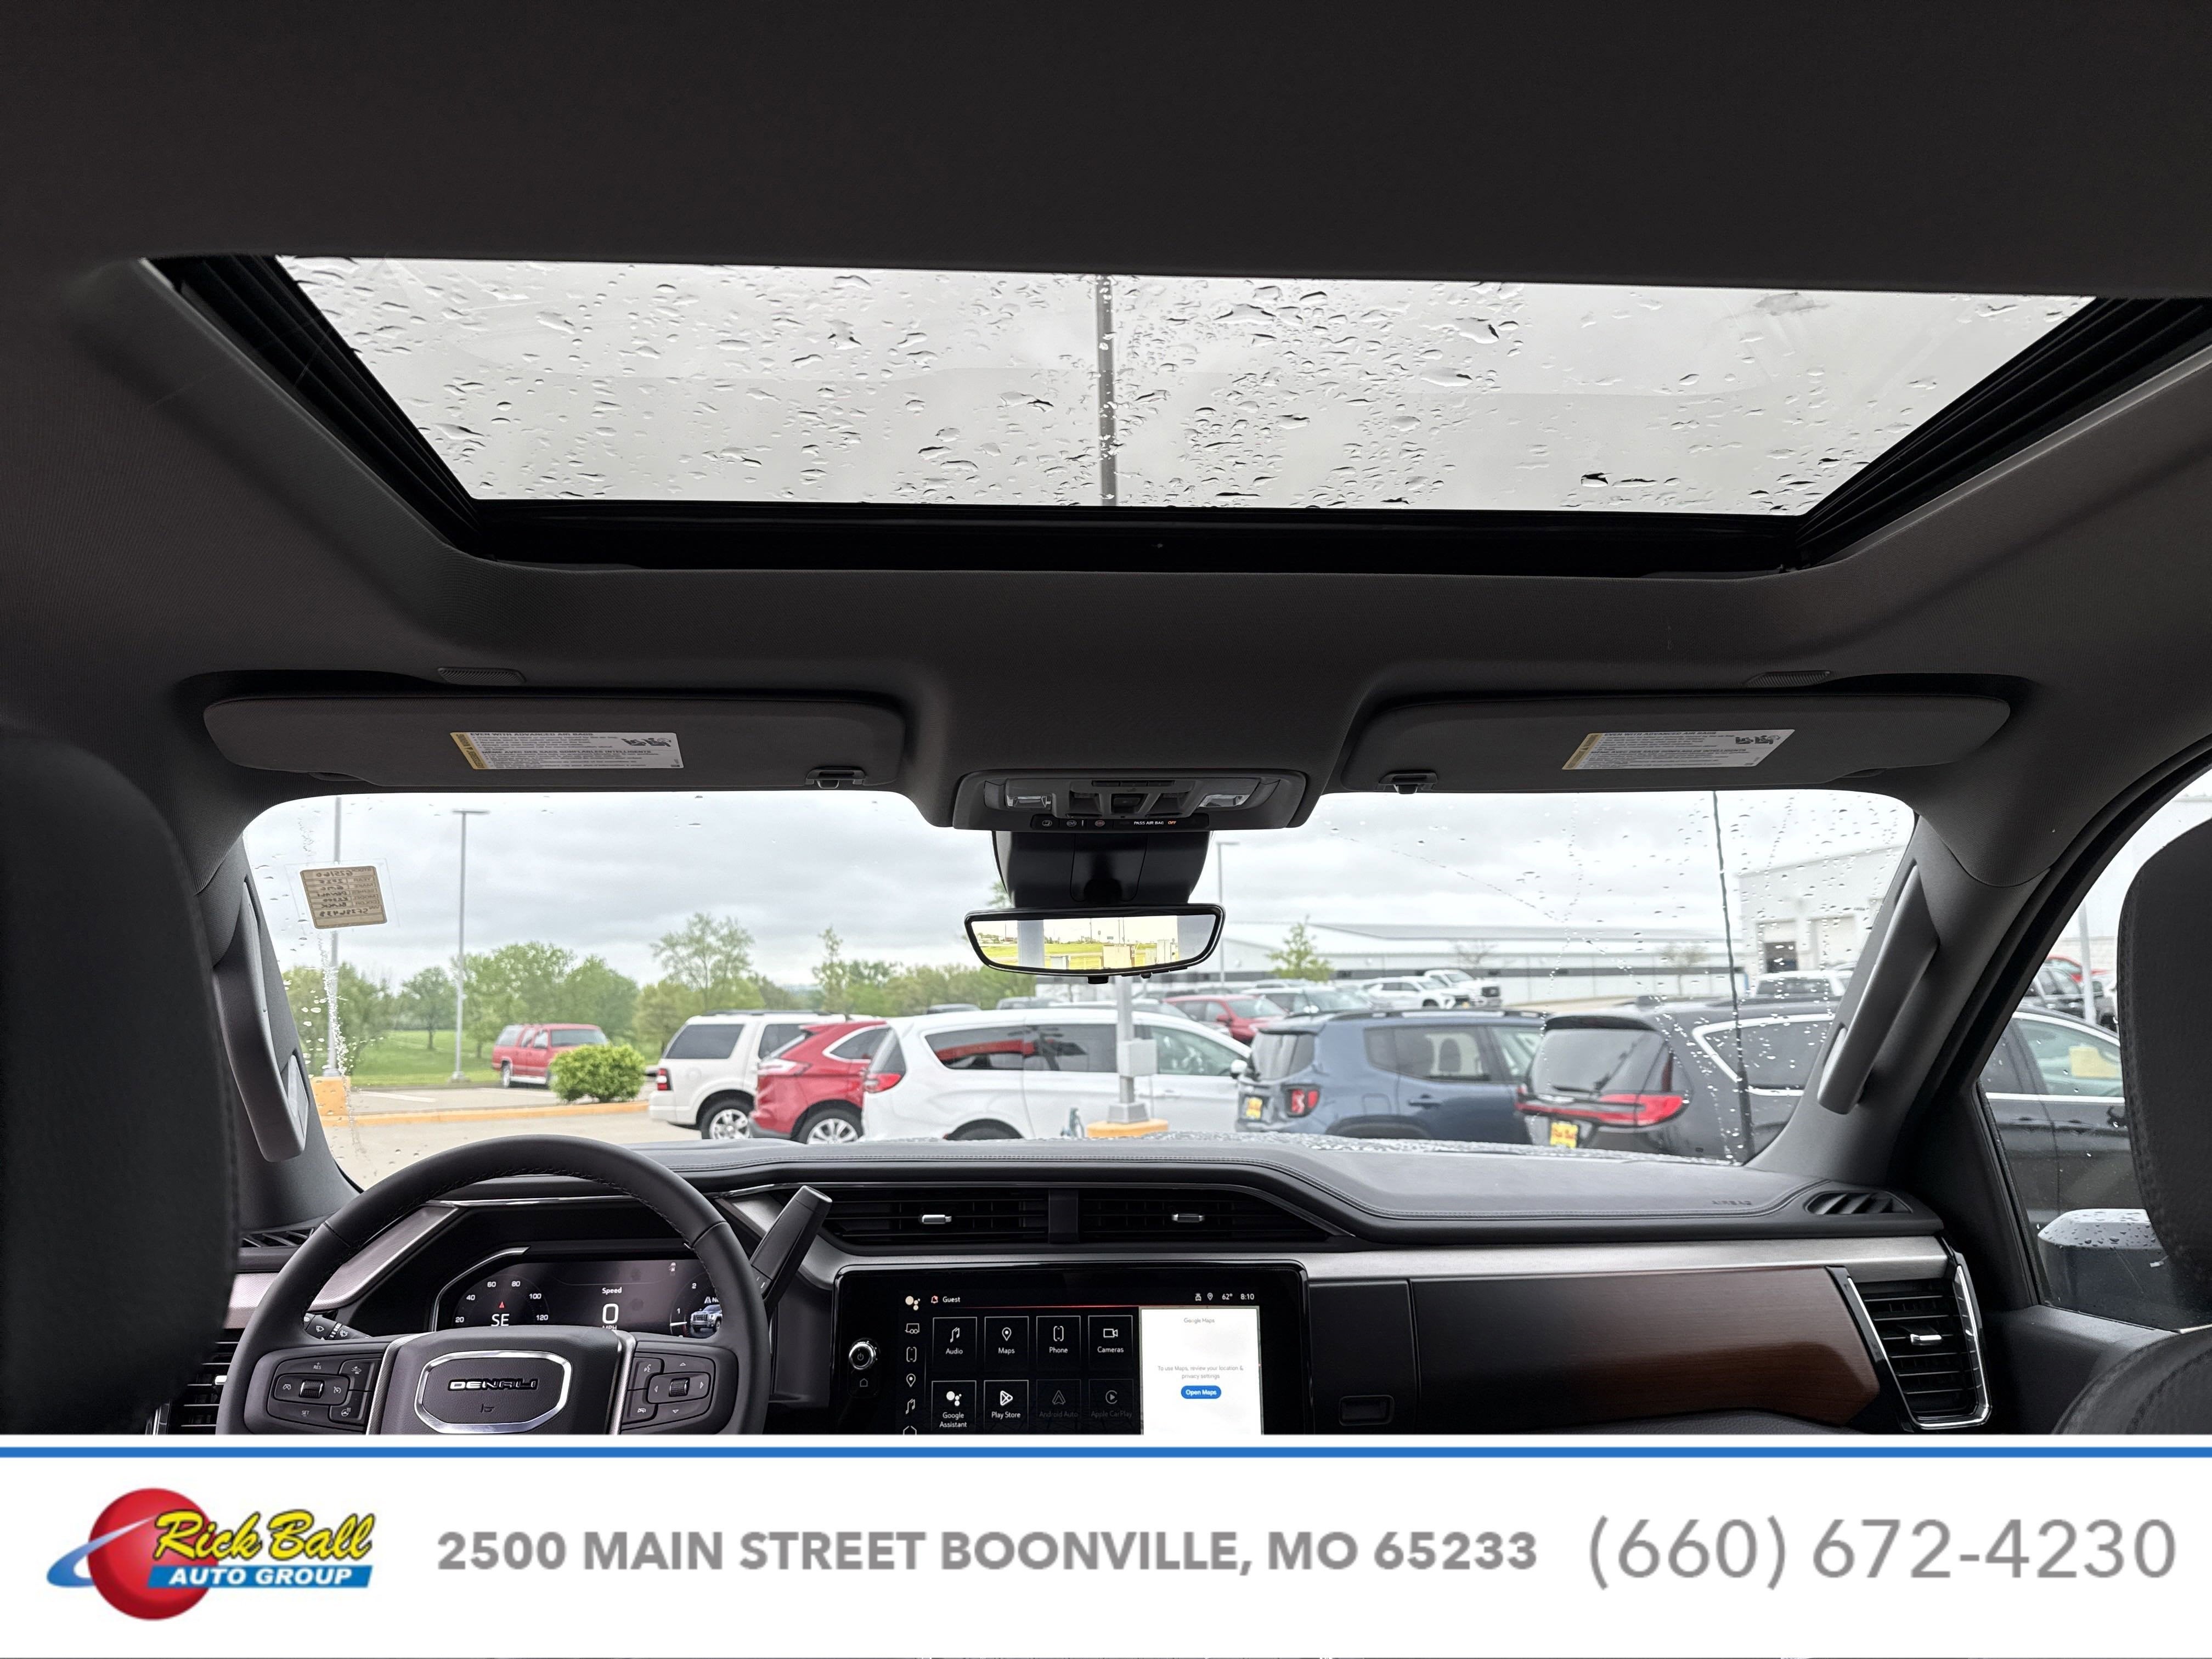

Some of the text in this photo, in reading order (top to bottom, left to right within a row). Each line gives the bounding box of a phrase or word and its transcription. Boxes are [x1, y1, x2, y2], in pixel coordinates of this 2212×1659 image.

[491, 1313, 510, 1327] SE
[602, 1304, 619, 1324] 0
[448, 1379, 538, 1390] DENALI
[942, 1412, 964, 1420] Google
